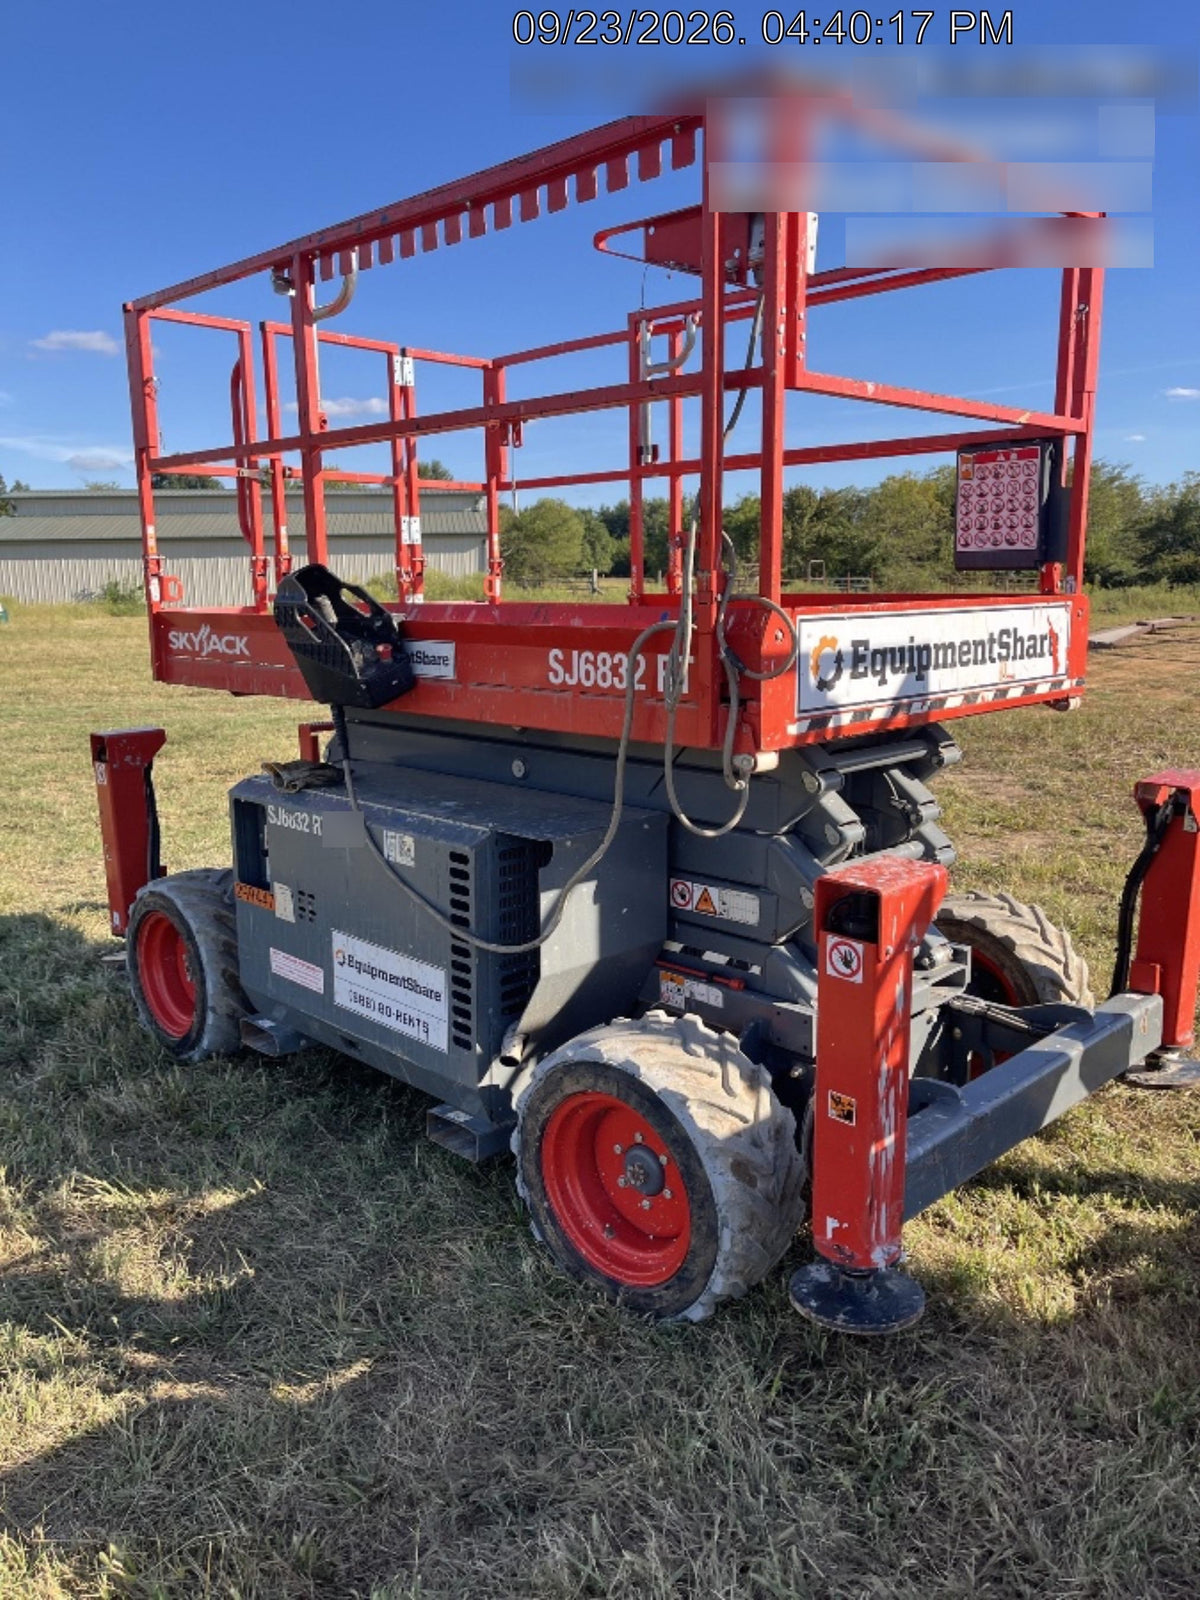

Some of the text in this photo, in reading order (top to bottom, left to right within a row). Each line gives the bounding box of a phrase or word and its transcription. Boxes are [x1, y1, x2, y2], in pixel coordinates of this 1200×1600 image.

[168, 623, 251, 657] SKYJACK
[548, 648, 647, 691] SJ6832
[347, 953, 442, 1002] EquipmentShare
